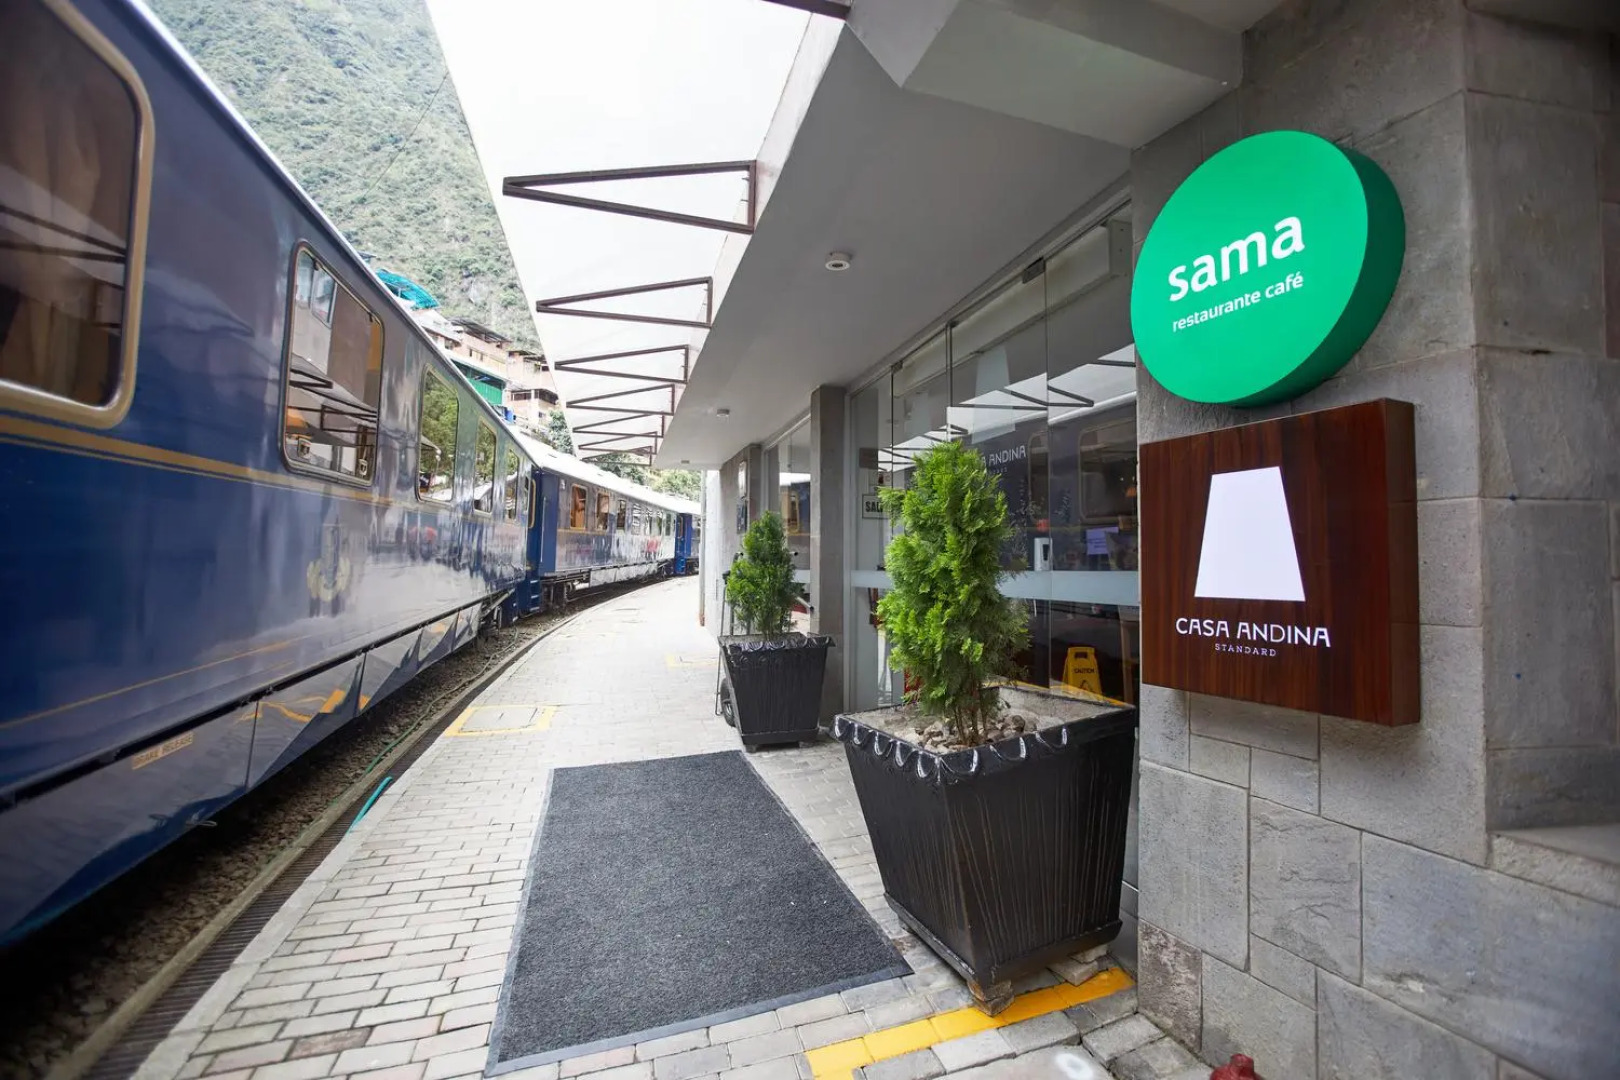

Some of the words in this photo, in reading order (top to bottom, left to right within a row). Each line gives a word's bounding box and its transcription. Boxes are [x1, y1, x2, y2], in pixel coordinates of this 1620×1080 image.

[1168, 216, 1305, 302] sama
[1172, 290, 1261, 333] restaurante
[1265, 271, 1304, 299] café
[988, 445, 1026, 466] ANDINA
[1175, 617, 1230, 638] CASA
[1236, 621, 1331, 648] ANDINA
[1214, 643, 1277, 657] STANDARD
